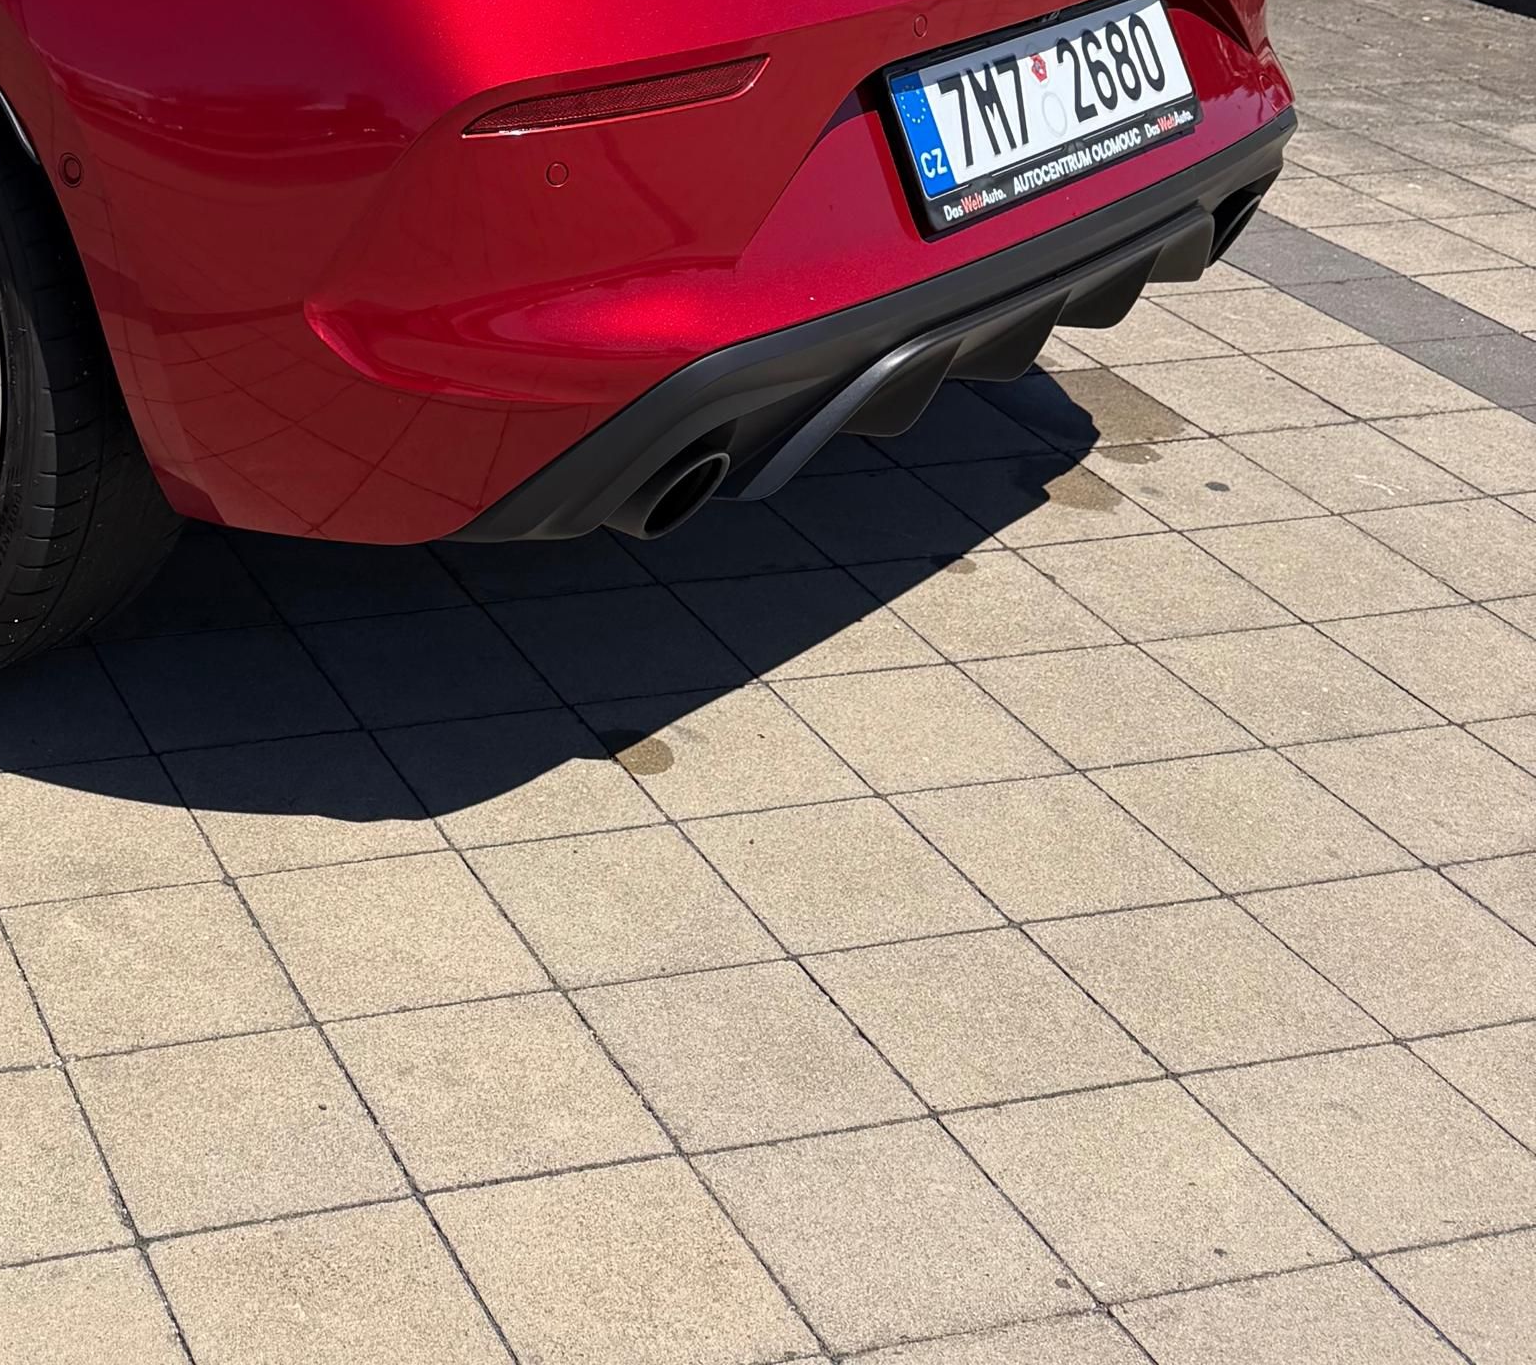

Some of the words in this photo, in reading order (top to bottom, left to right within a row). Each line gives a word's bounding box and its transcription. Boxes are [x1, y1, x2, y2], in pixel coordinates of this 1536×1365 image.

[937, 54, 1029, 168] 7M7
[1057, 12, 1166, 124] 2680
[920, 148, 948, 179] CZ
[1012, 147, 1093, 195] AUTOCENTRUM
[1091, 127, 1142, 162] OLOMOUC
